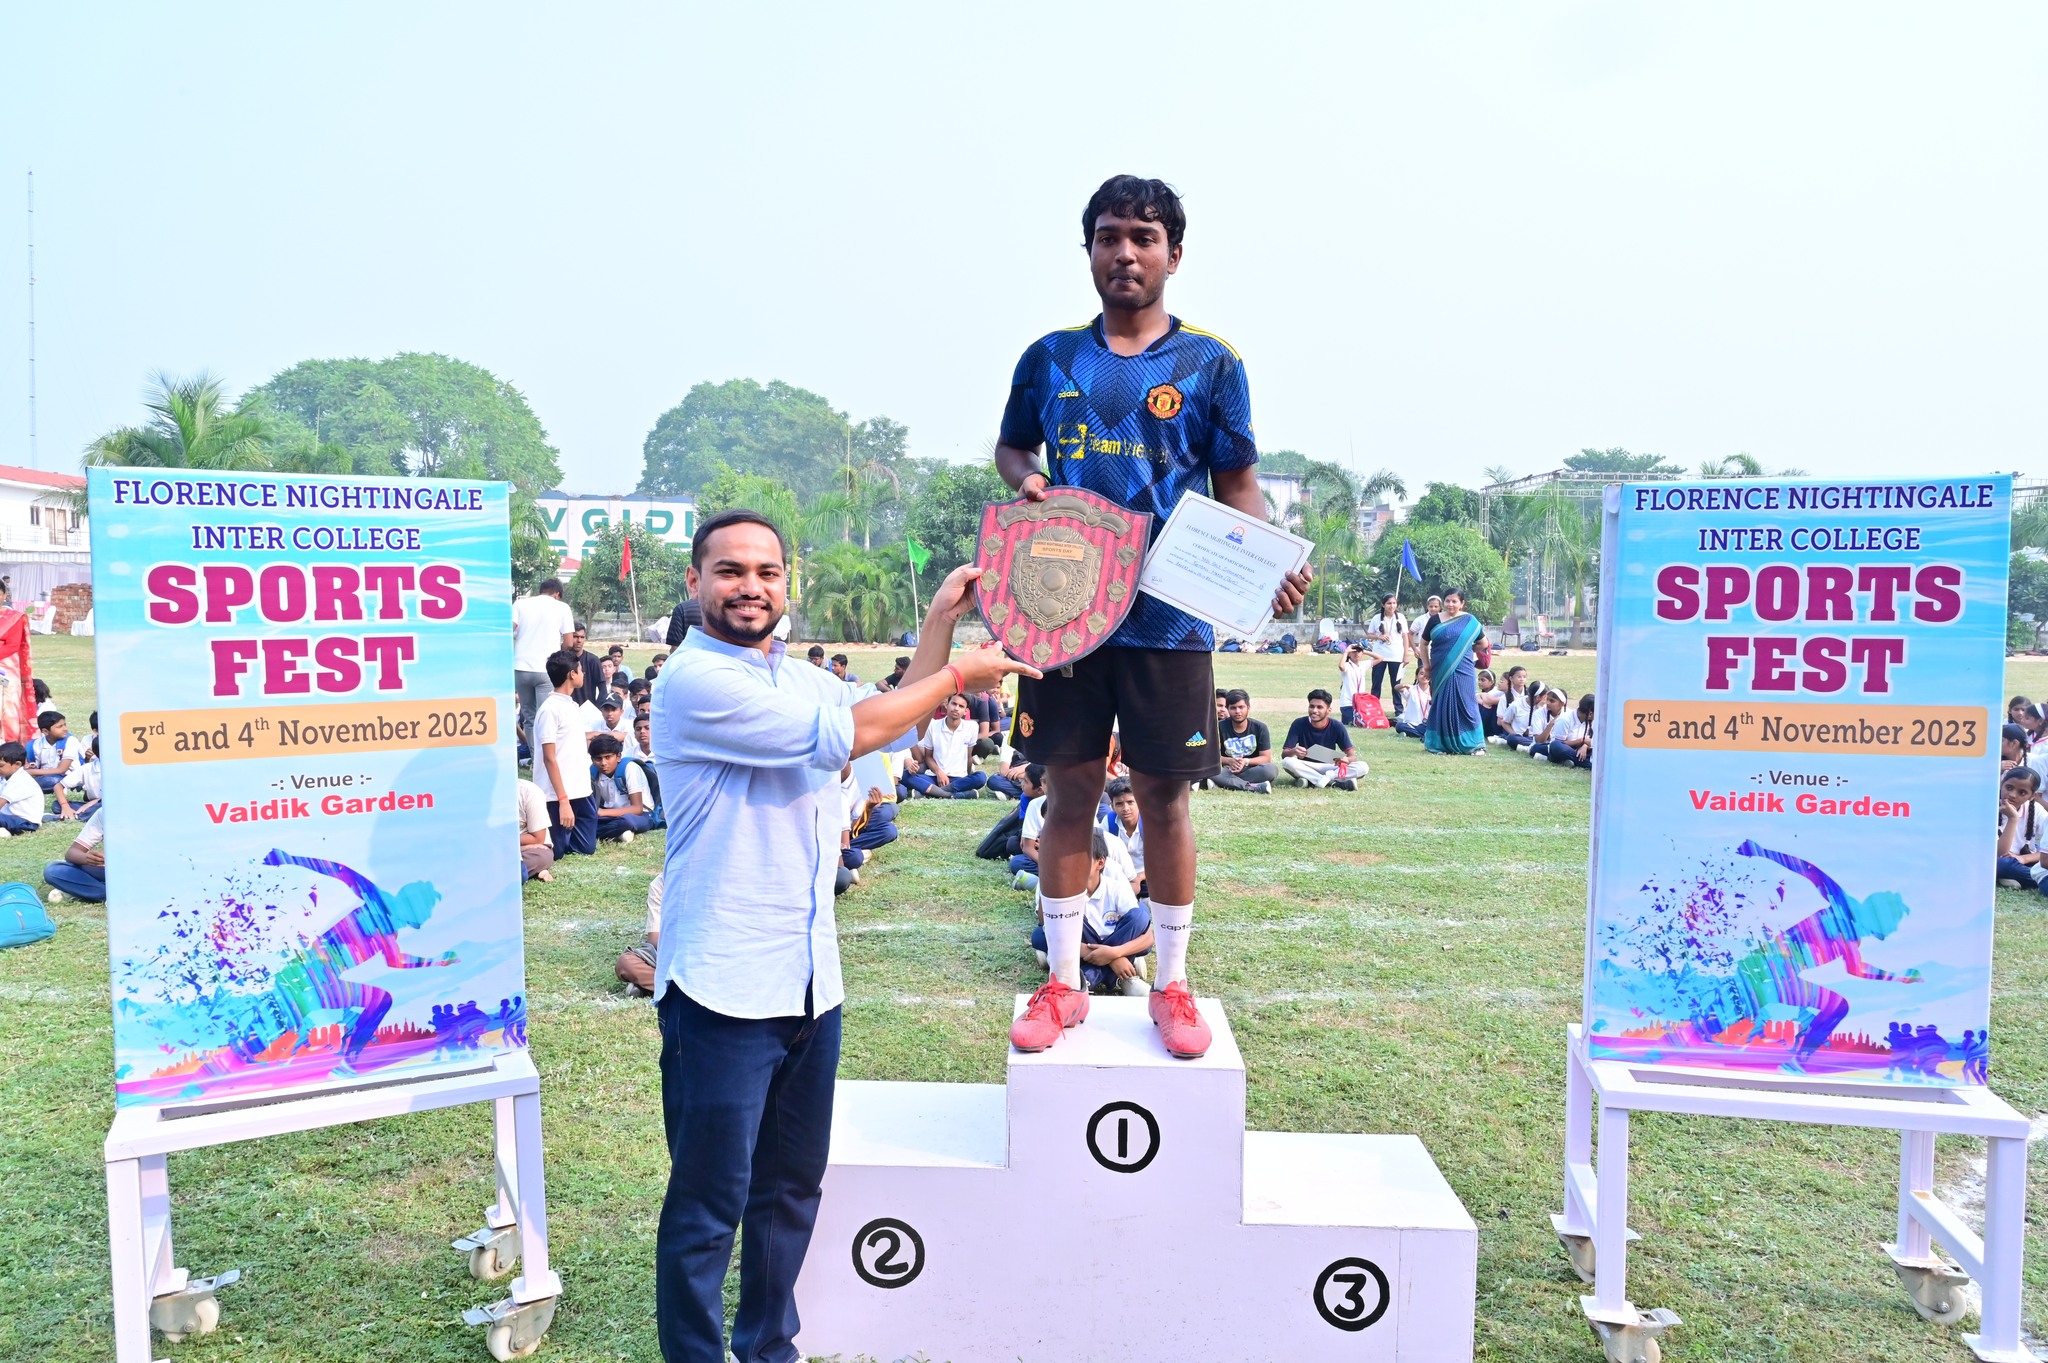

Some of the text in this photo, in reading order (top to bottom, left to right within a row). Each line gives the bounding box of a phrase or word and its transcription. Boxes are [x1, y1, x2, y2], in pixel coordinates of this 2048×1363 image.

[1057, 390, 1079, 399] adidas
[113, 480, 483, 511] FLORENCE NIGHTINGALE
[1635, 484, 1994, 511] FLORENCE NIGHTINGALE
[191, 526, 421, 550] INTER COLLEGE
[1698, 527, 1921, 551] INTER COLLEGE
[147, 565, 463, 624] SPORTS
[1657, 565, 1961, 623] SPORTS
[211, 636, 415, 696] FEST
[1706, 637, 1904, 693] FEST
[132, 710, 488, 754] 3rd and 4th November 2023
[1632, 709, 1977, 747] 3rd and 4th November 2023
[290, 774, 353, 789] Venue
[1769, 770, 1829, 787] Venue
[205, 791, 434, 824] Vaidik Garden
[1689, 789, 1910, 818] Vaidik Garden
[867, 1229, 909, 1275] 2
[1332, 1273, 1367, 1320] 3
